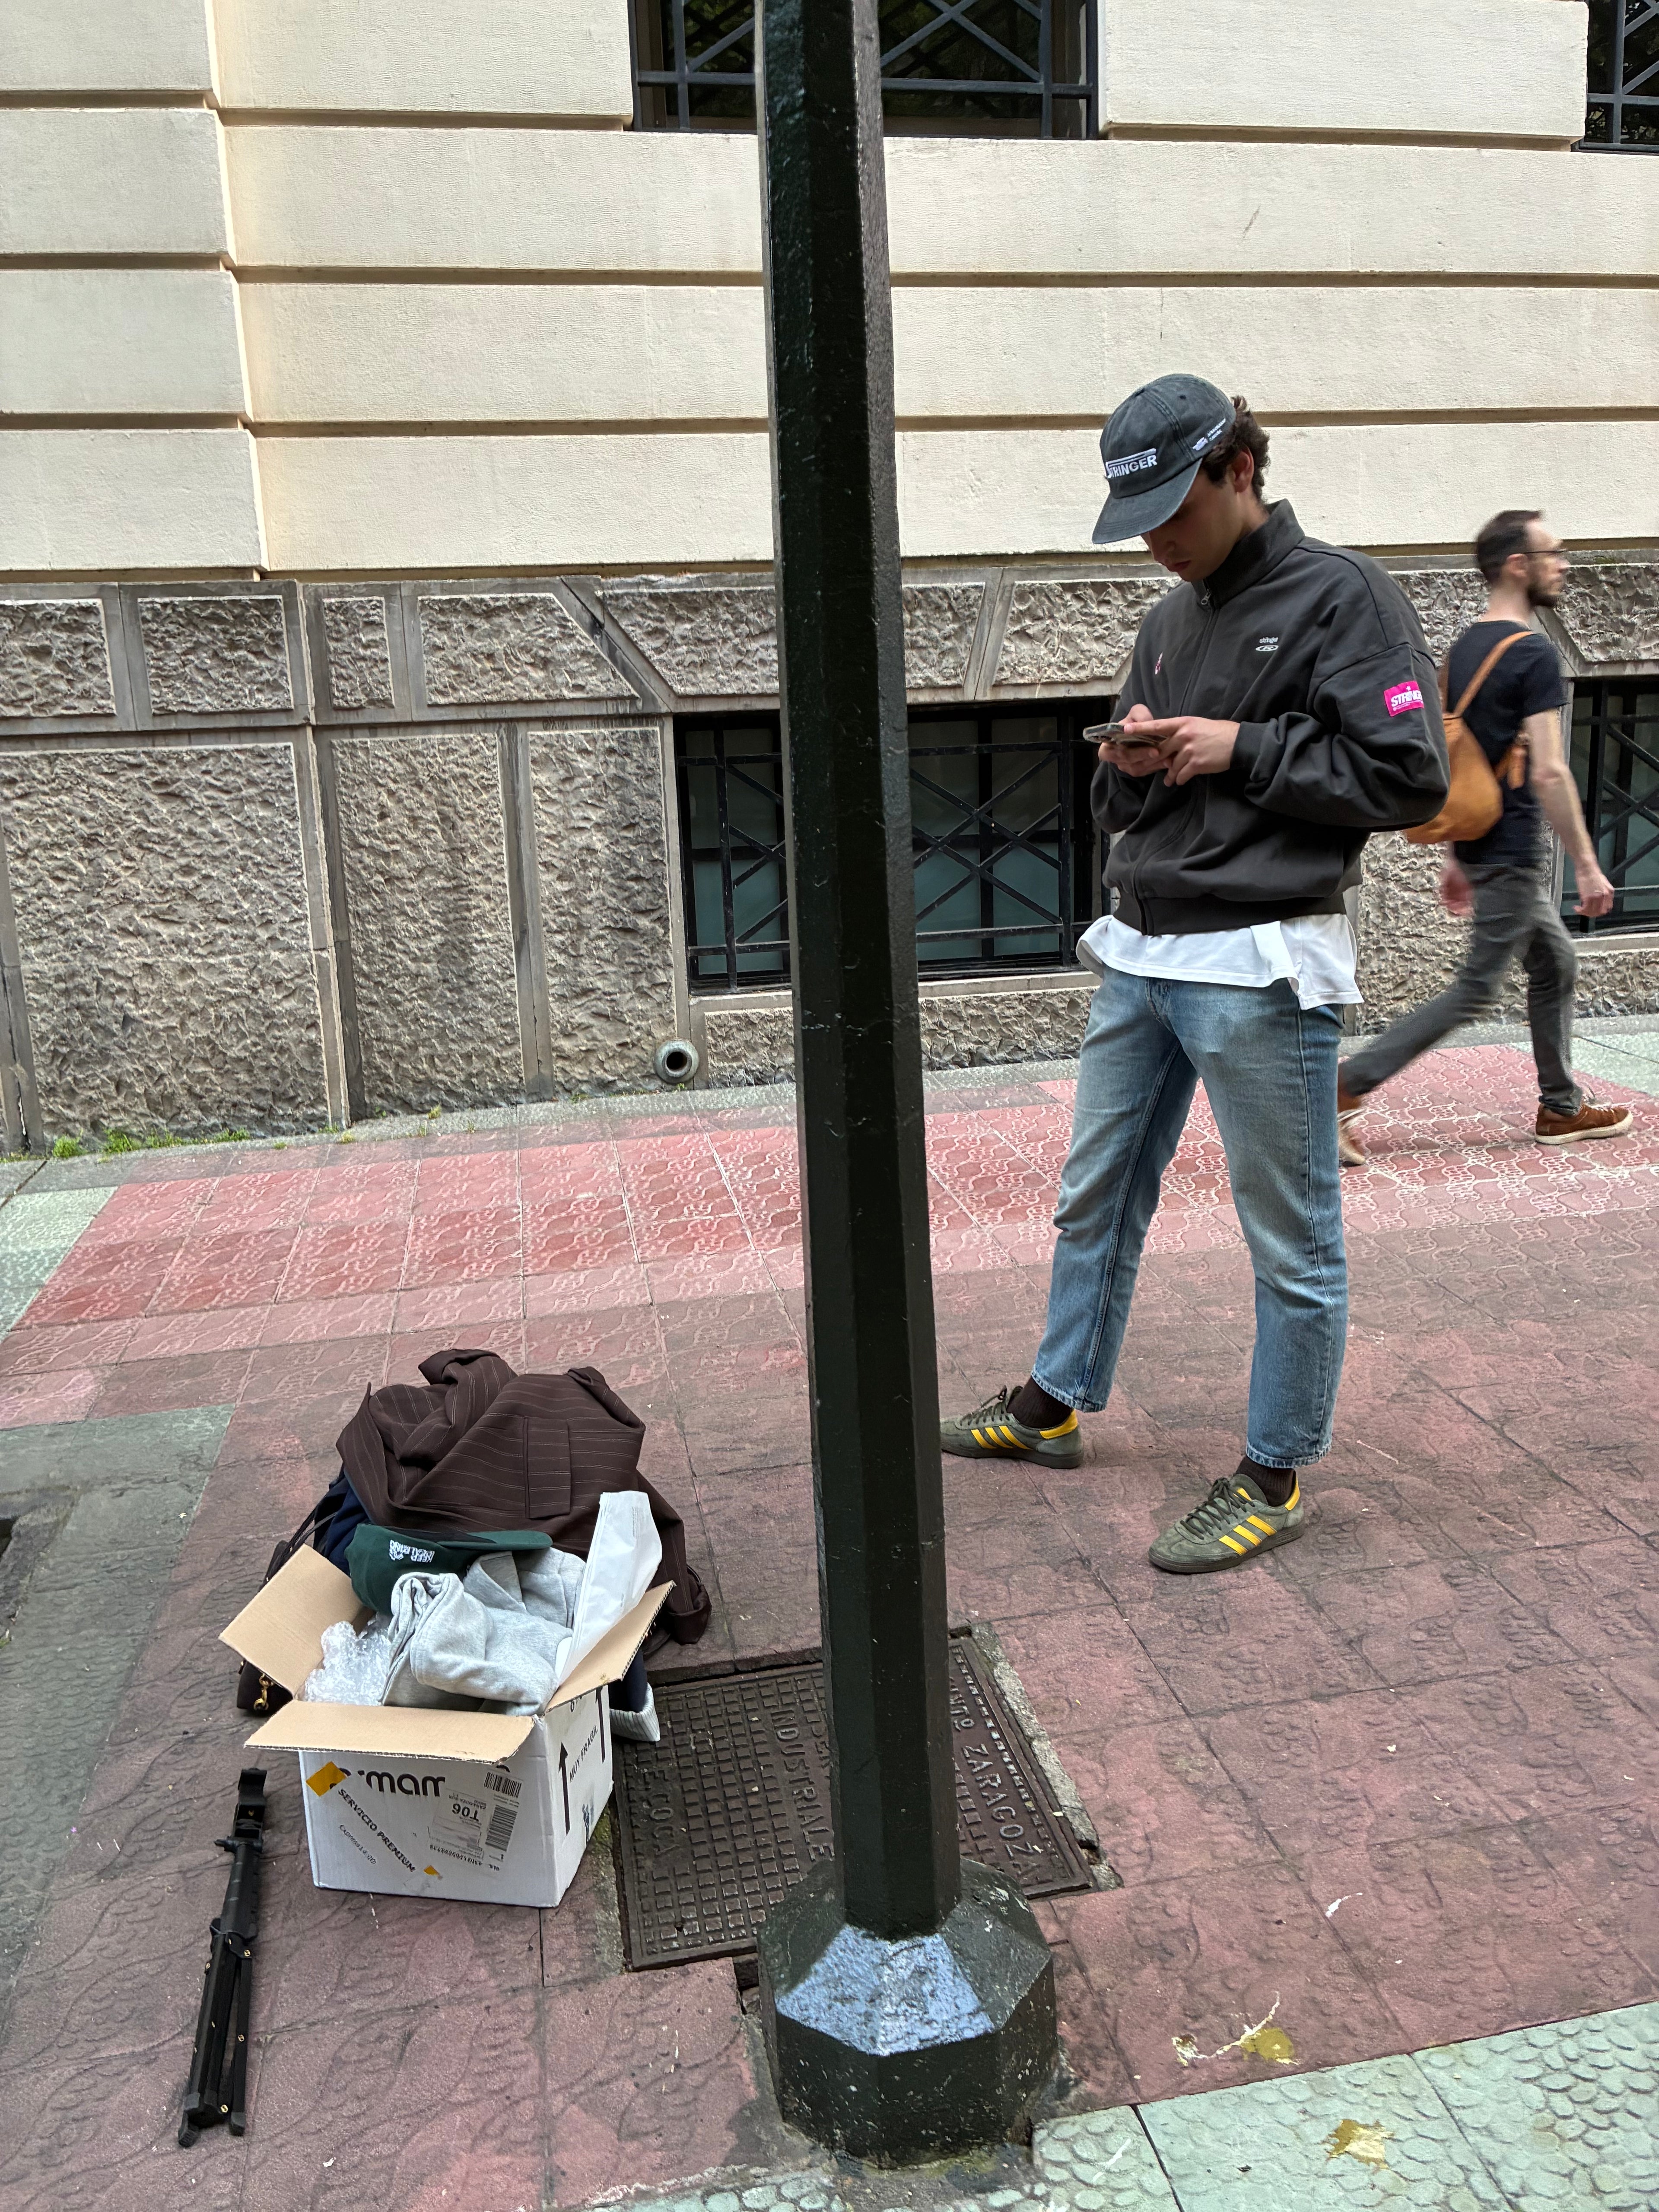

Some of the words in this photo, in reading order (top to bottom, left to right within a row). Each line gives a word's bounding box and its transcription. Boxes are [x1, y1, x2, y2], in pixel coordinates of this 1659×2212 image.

[1105, 448, 1158, 479] STRINGER
[338, 1789, 377, 1831] SERVICIO
[377, 1830, 416, 1872] PREMIUM
